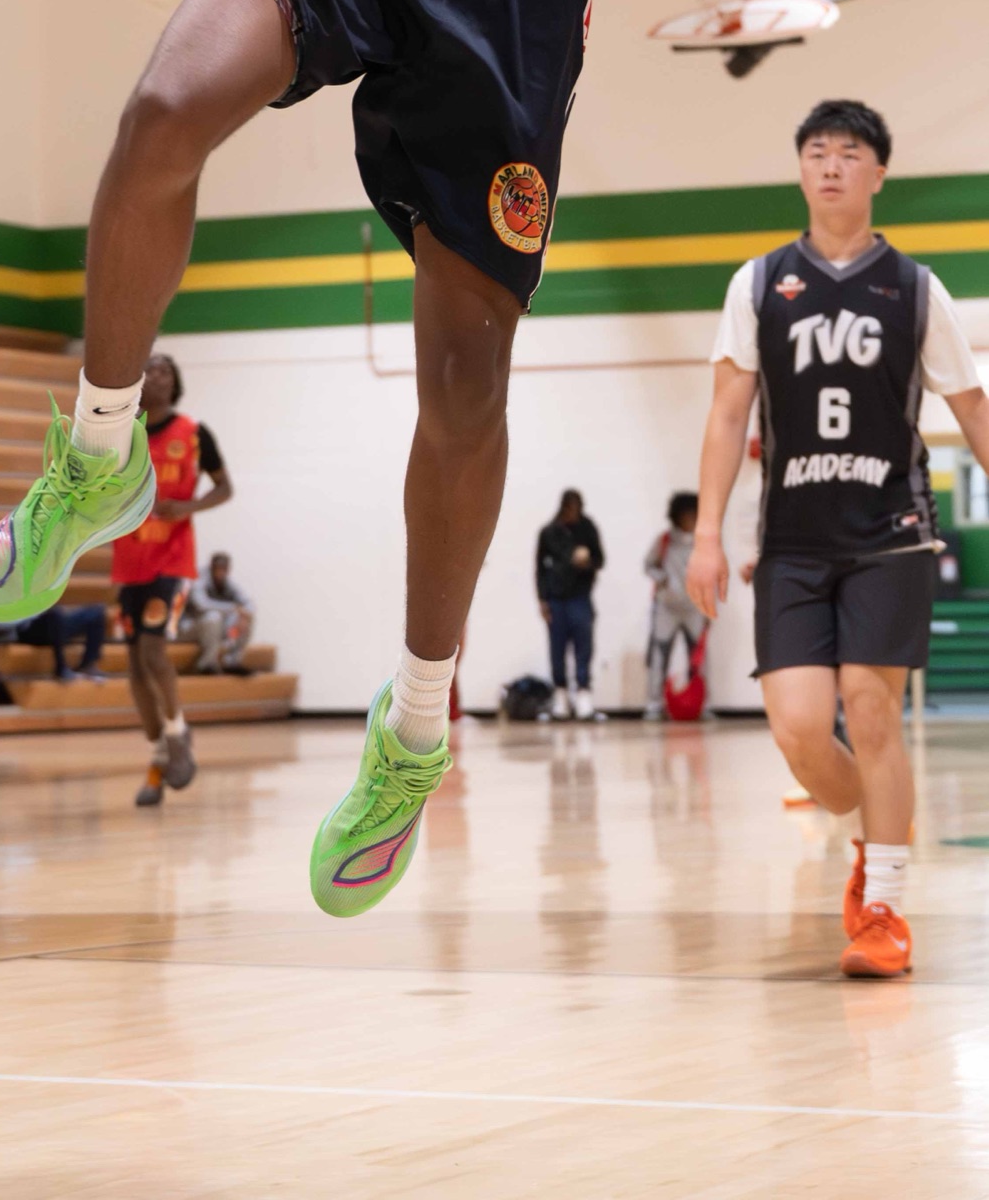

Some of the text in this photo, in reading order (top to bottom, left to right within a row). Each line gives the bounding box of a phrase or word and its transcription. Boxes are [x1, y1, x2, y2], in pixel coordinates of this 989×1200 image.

[788, 308, 884, 374] TVG
[817, 387, 852, 441] 6
[782, 453, 892, 489] ACADEMY
